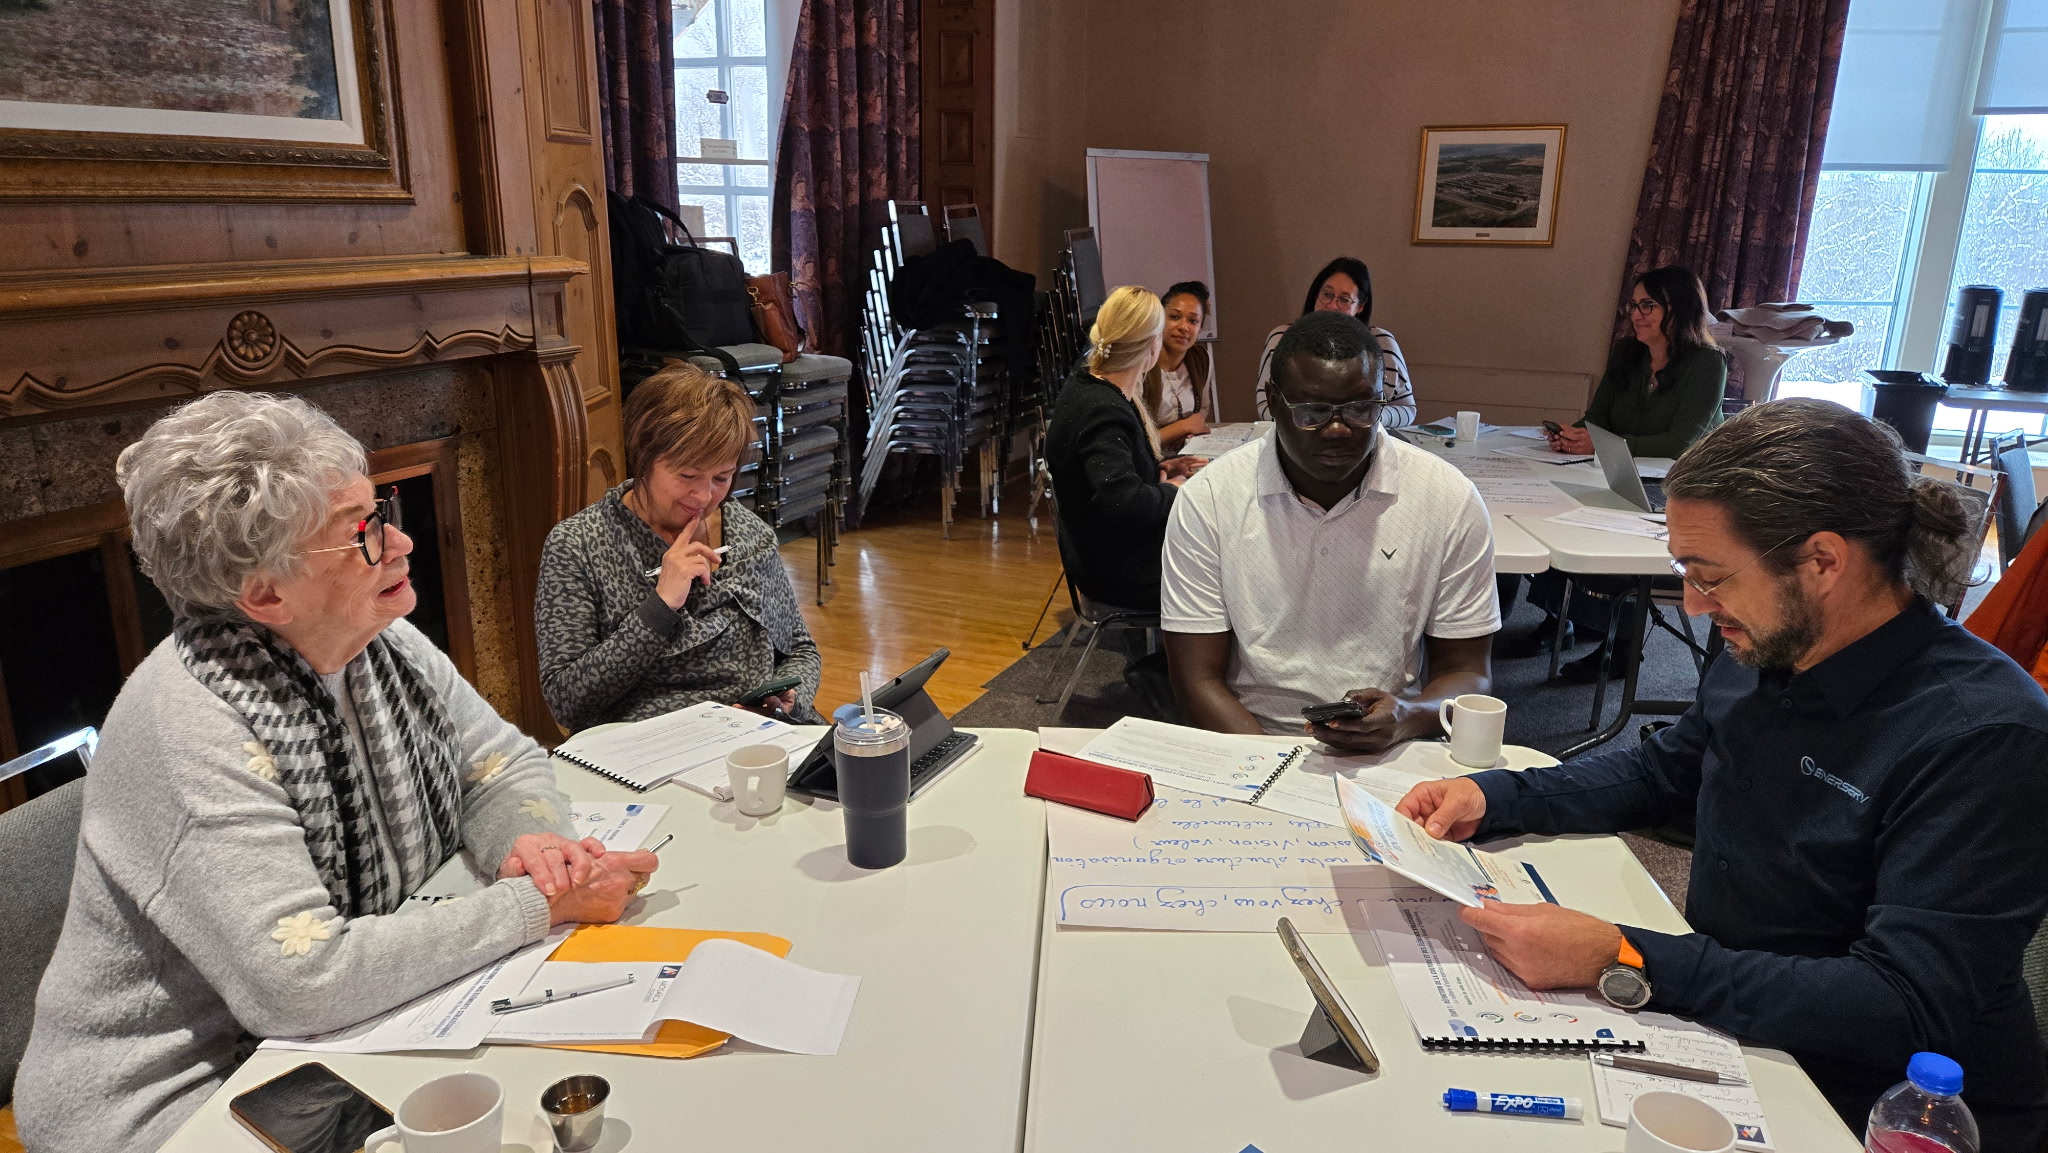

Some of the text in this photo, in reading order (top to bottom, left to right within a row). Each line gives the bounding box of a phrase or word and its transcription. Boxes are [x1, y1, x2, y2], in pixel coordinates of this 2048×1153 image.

[1156, 888, 1218, 917] chez
[1281, 887, 1343, 915] chez
[1494, 1095, 1534, 1111] EXPO
